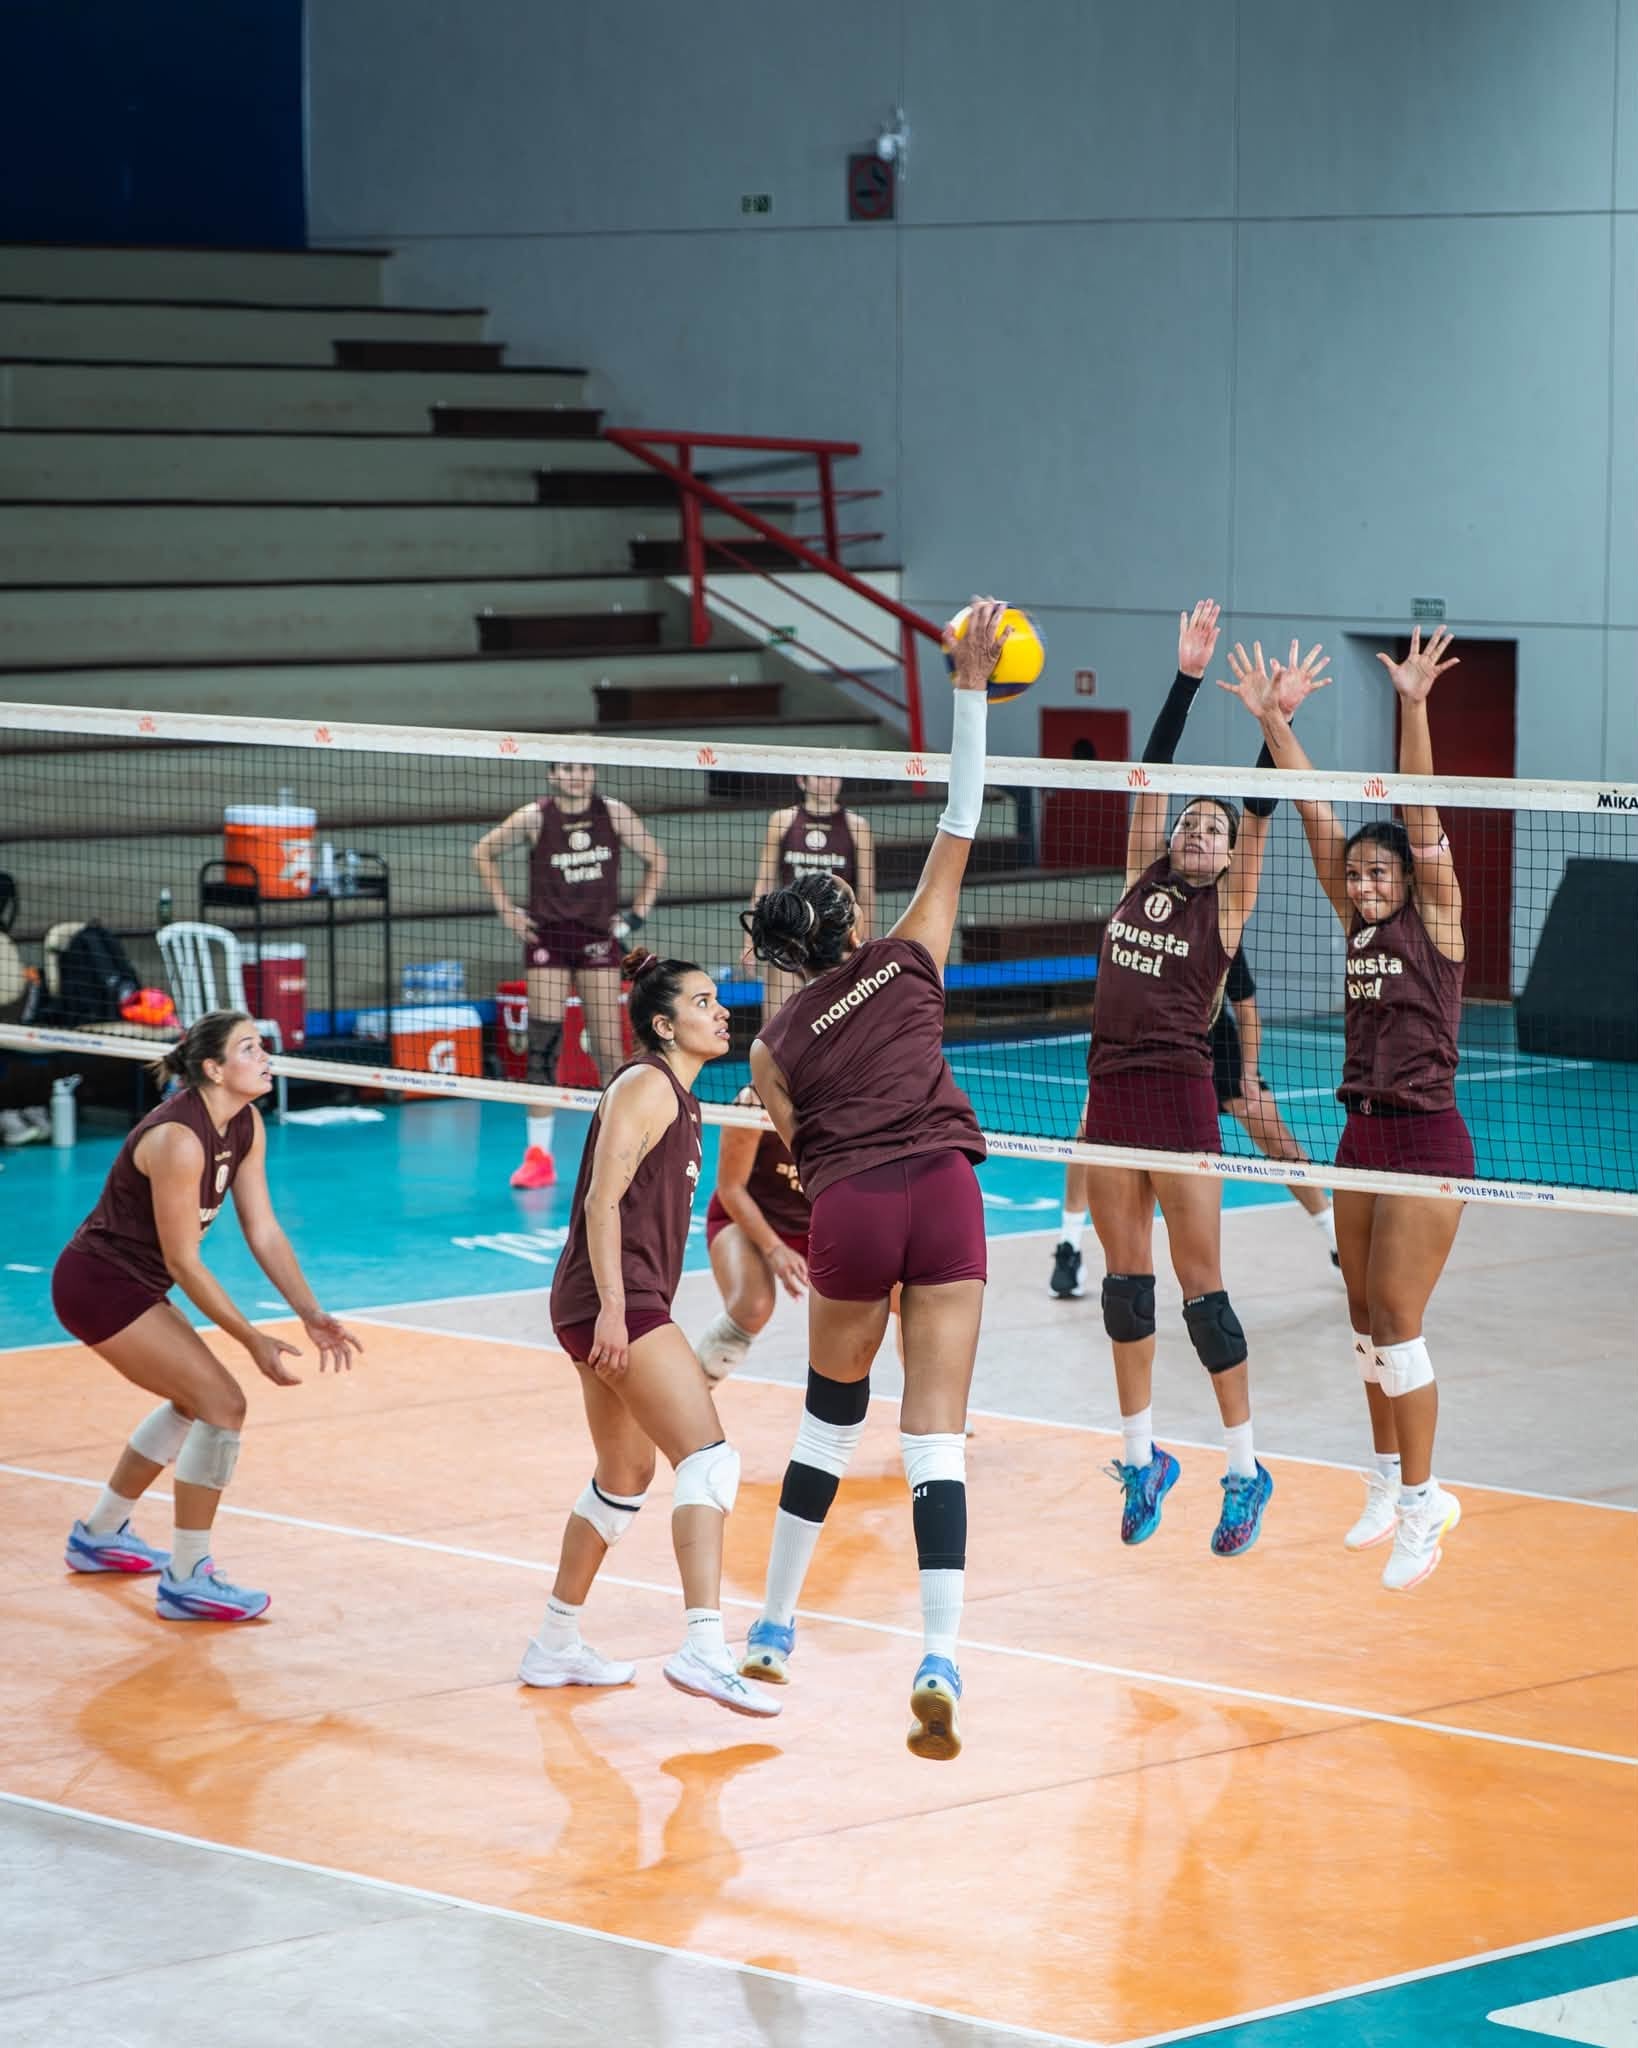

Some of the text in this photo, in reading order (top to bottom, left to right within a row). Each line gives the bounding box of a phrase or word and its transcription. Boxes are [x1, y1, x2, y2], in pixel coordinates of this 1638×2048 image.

[1127, 767, 1151, 787] VNL
[1364, 776, 1388, 798] VNL
[1111, 943, 1164, 978] total
[810, 961, 901, 1035] marathon
[987, 1140, 1038, 1153] VOLLEYBALL
[1214, 1162, 1269, 1176] VOLLEYBALL
[1457, 1184, 1515, 1199] VOLLEYBALL
